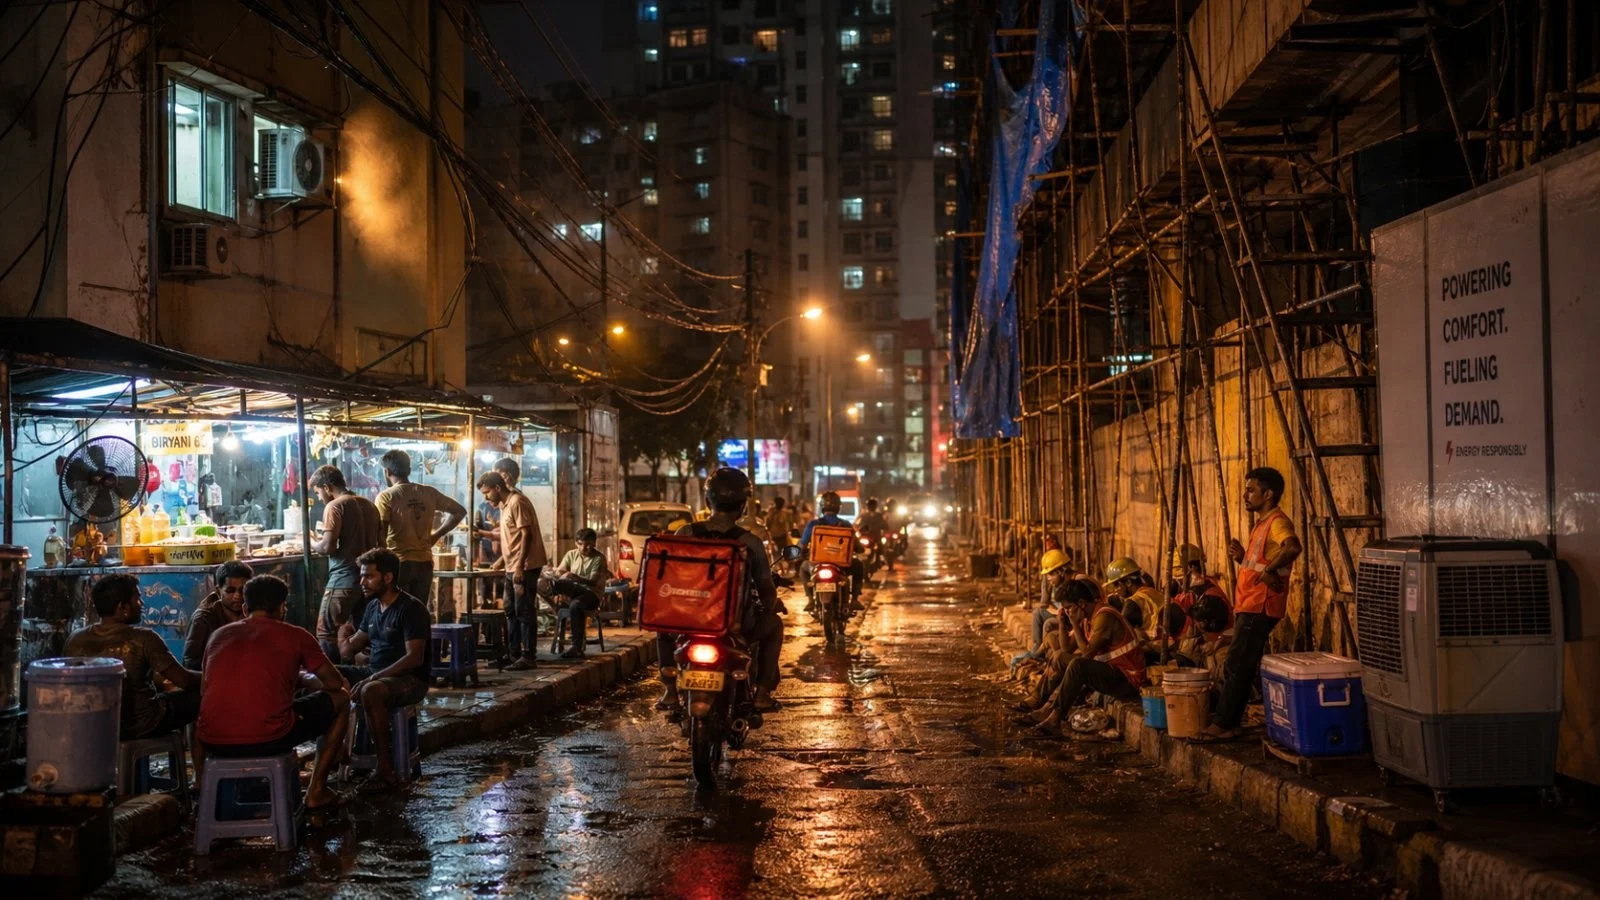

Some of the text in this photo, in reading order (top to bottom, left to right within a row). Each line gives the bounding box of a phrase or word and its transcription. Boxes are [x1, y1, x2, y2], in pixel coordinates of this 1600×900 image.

[1442, 260, 1512, 302] POWERING
[1443, 307, 1508, 343] COMFORT.
[1444, 354, 1498, 385] FUELING
[1445, 399, 1504, 427] DEMAND.
[152, 435, 191, 448] BIRYANI
[1456, 444, 1528, 457] ENERGY RESPONSIBLY
